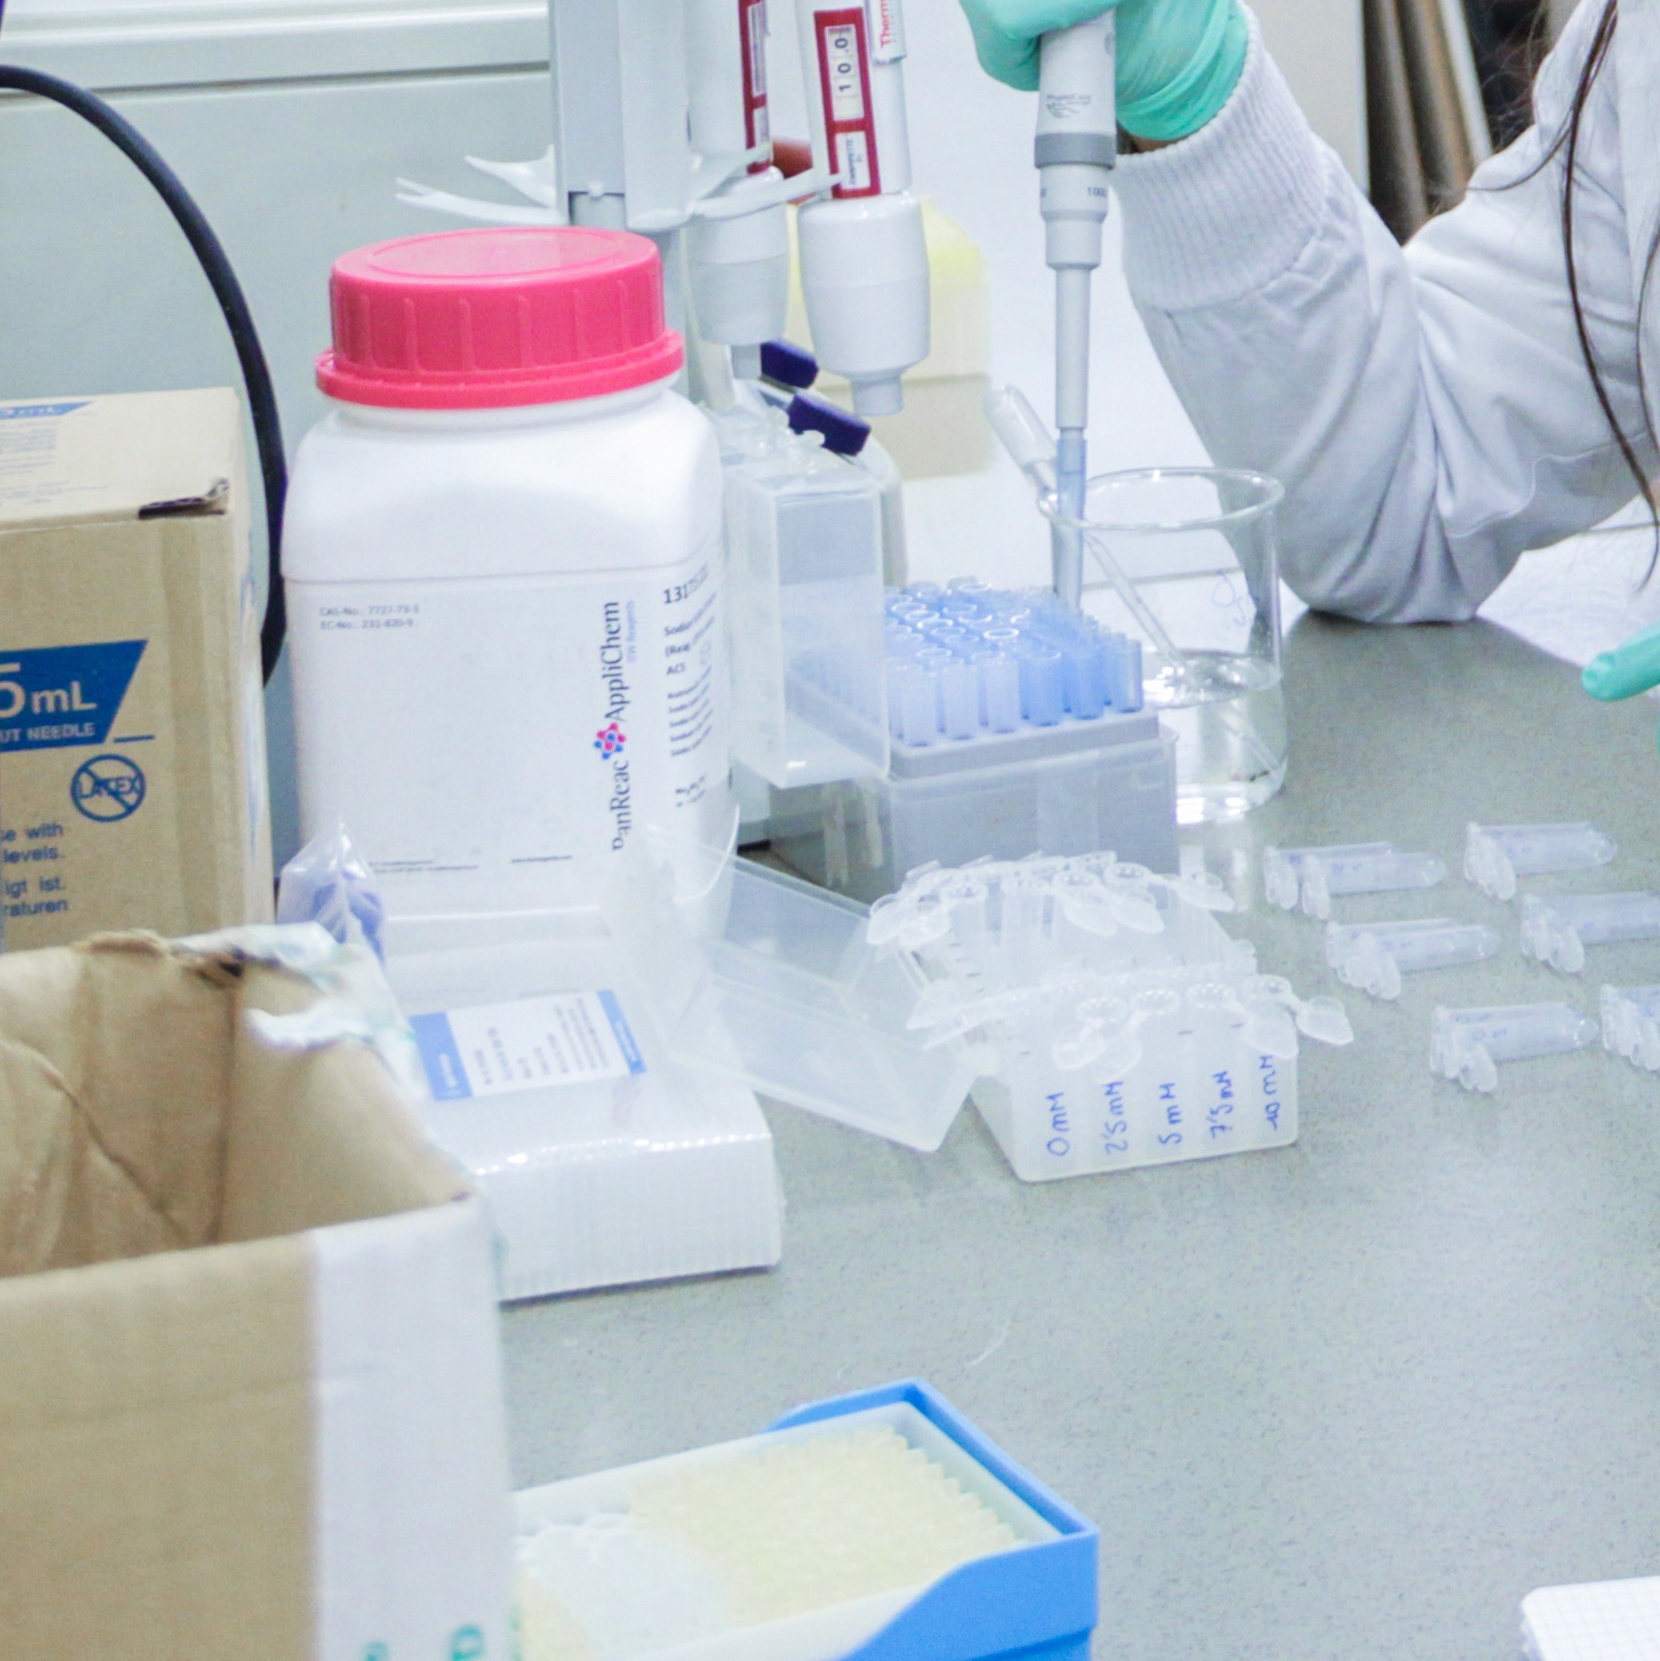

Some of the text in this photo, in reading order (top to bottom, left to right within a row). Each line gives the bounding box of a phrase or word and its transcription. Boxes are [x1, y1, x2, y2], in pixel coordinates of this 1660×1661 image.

[601, 600, 631, 723] AppliChem
[26, 721, 95, 741] NEEDLE
[26, 822, 63, 841] with
